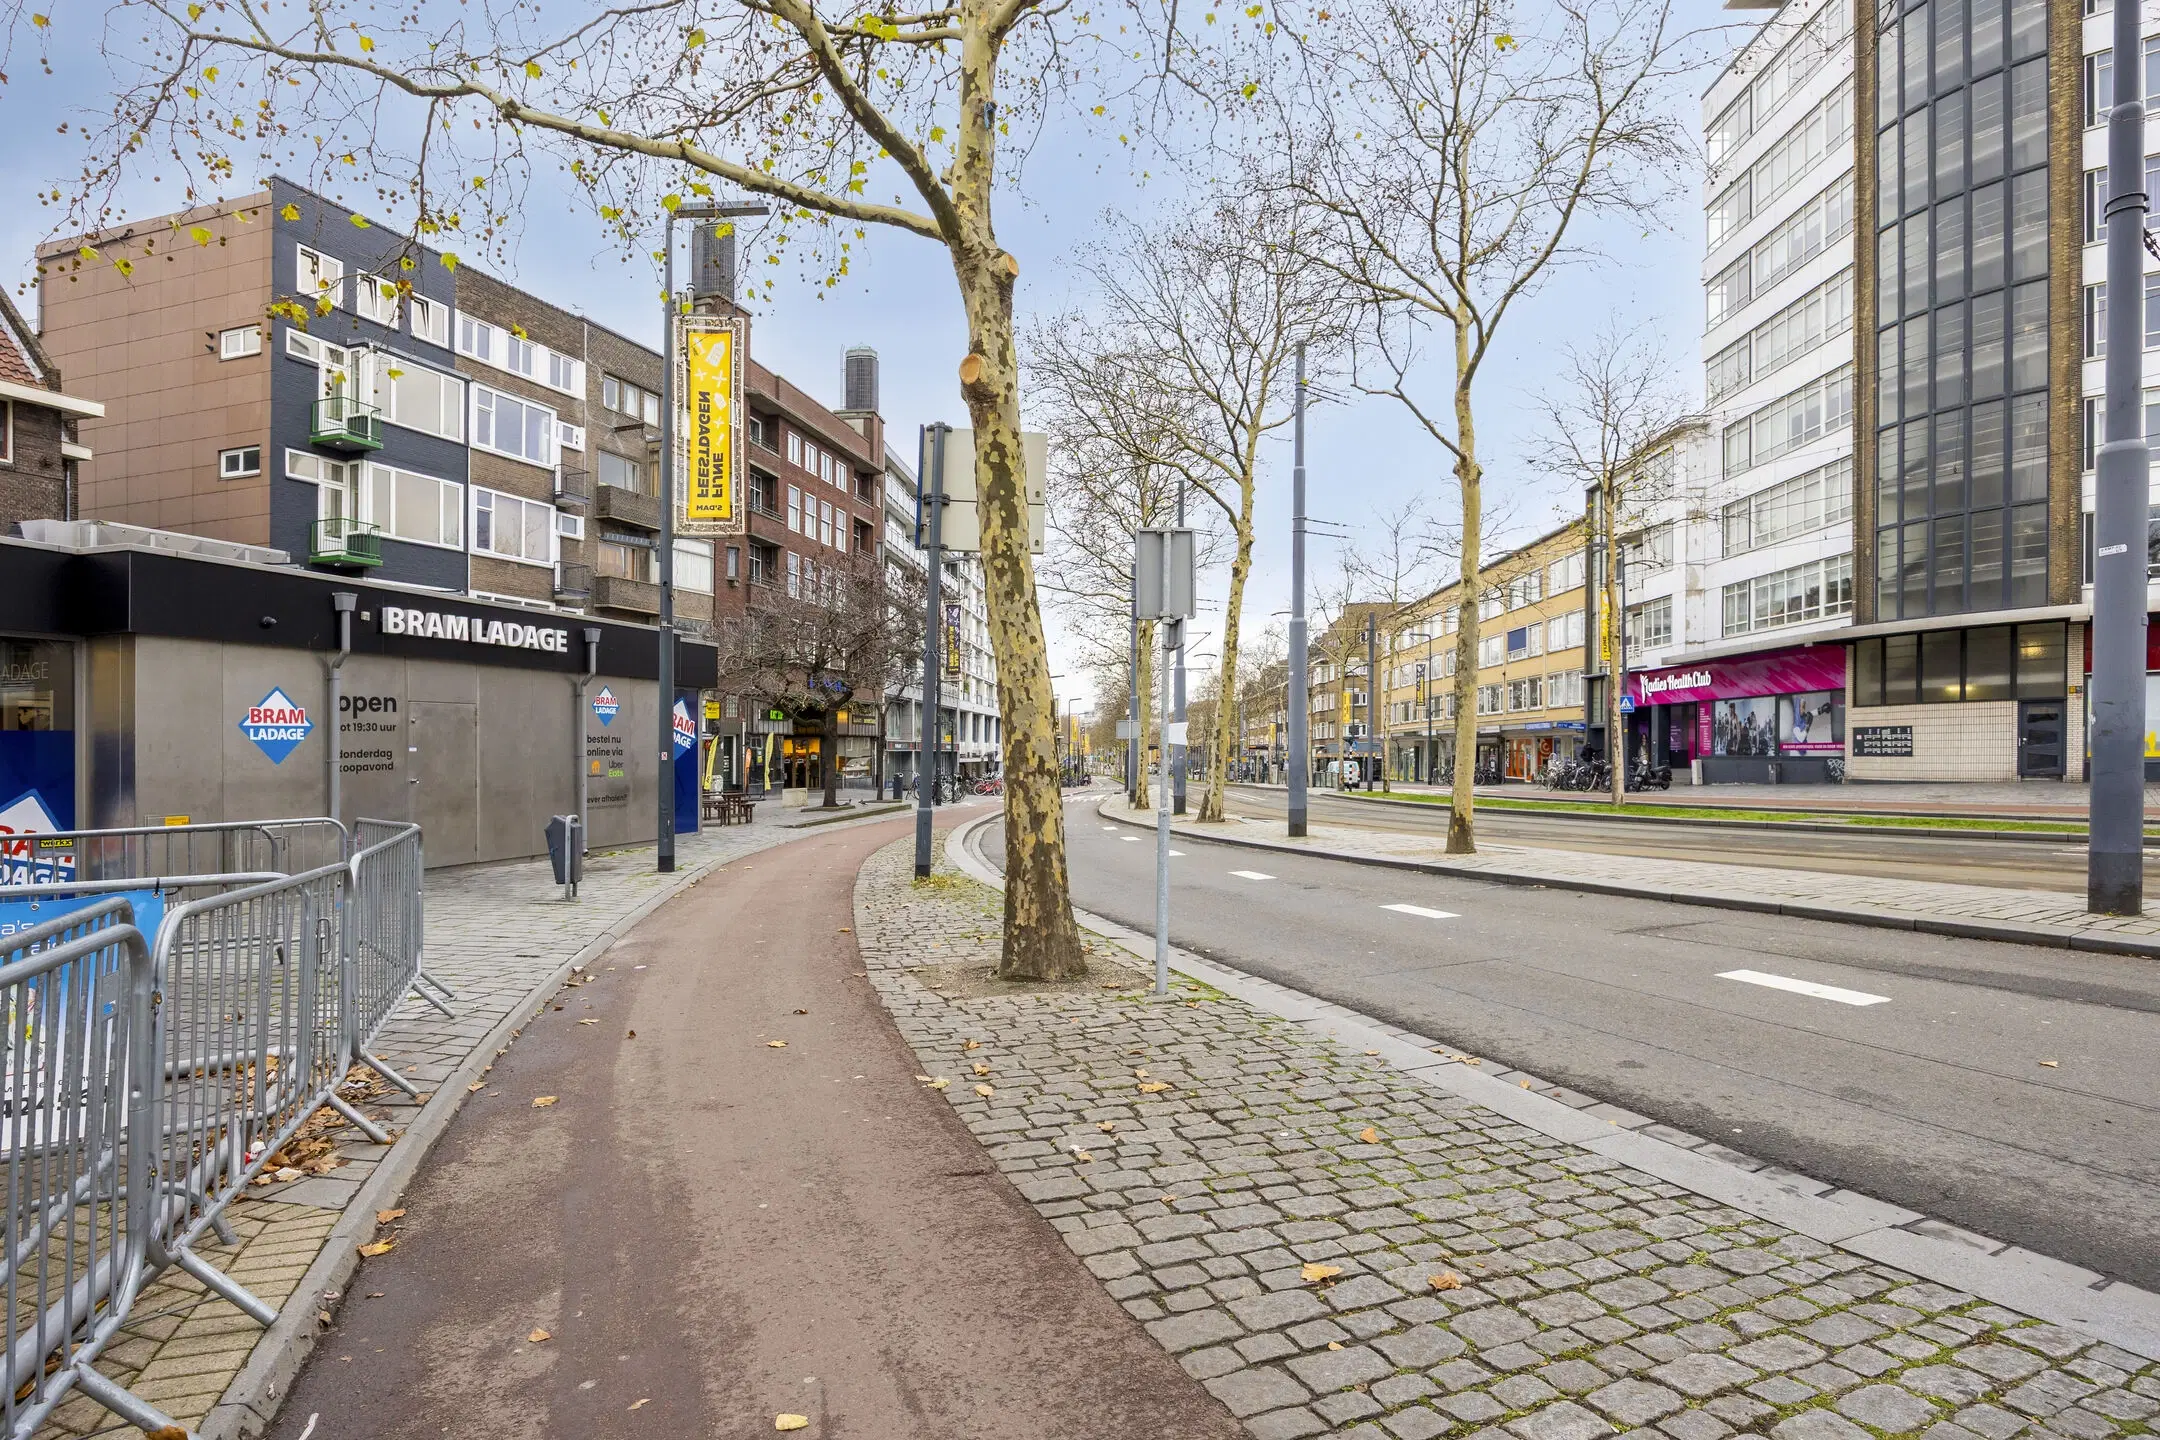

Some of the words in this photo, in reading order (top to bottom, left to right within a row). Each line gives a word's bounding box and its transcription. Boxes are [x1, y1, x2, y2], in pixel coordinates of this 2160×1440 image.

[382, 606, 469, 642] BRAM
[471, 618, 567, 653] LADAGE
[1667, 673, 1693, 690] Health
[1693, 670, 1712, 687] Club
[339, 695, 397, 719] open
[595, 697, 616, 705] BRAM
[250, 708, 304, 724] BRAM
[340, 723, 351, 732] ot
[353, 723, 378, 732] 19:30
[249, 728, 304, 741] LADAGE
[587, 735, 610, 744] bestel
[611, 736, 621, 744] nu
[587, 747, 610, 756] online
[612, 747, 623, 756] via
